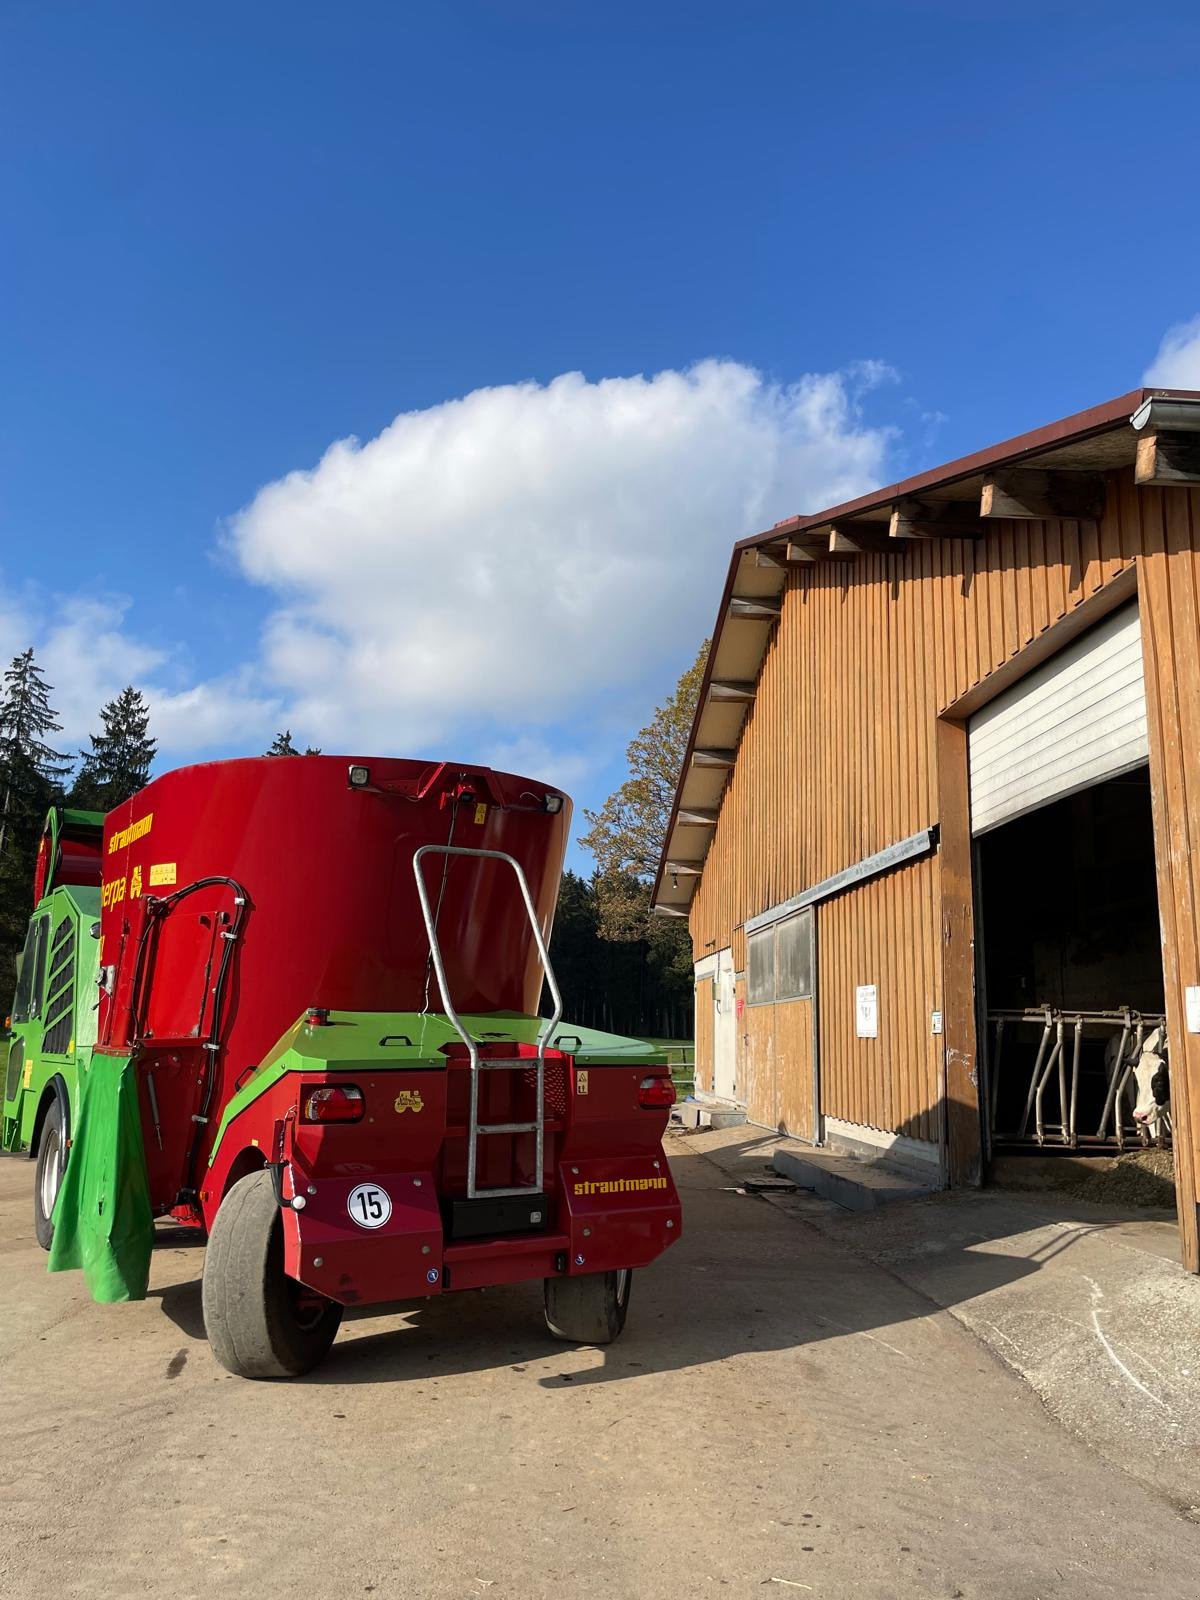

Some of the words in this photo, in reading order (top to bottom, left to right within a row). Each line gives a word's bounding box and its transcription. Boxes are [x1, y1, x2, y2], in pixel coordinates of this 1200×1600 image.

[108, 812, 153, 854] strautmann
[574, 1177, 667, 1195] strautmann
[357, 1191, 383, 1220] 15
